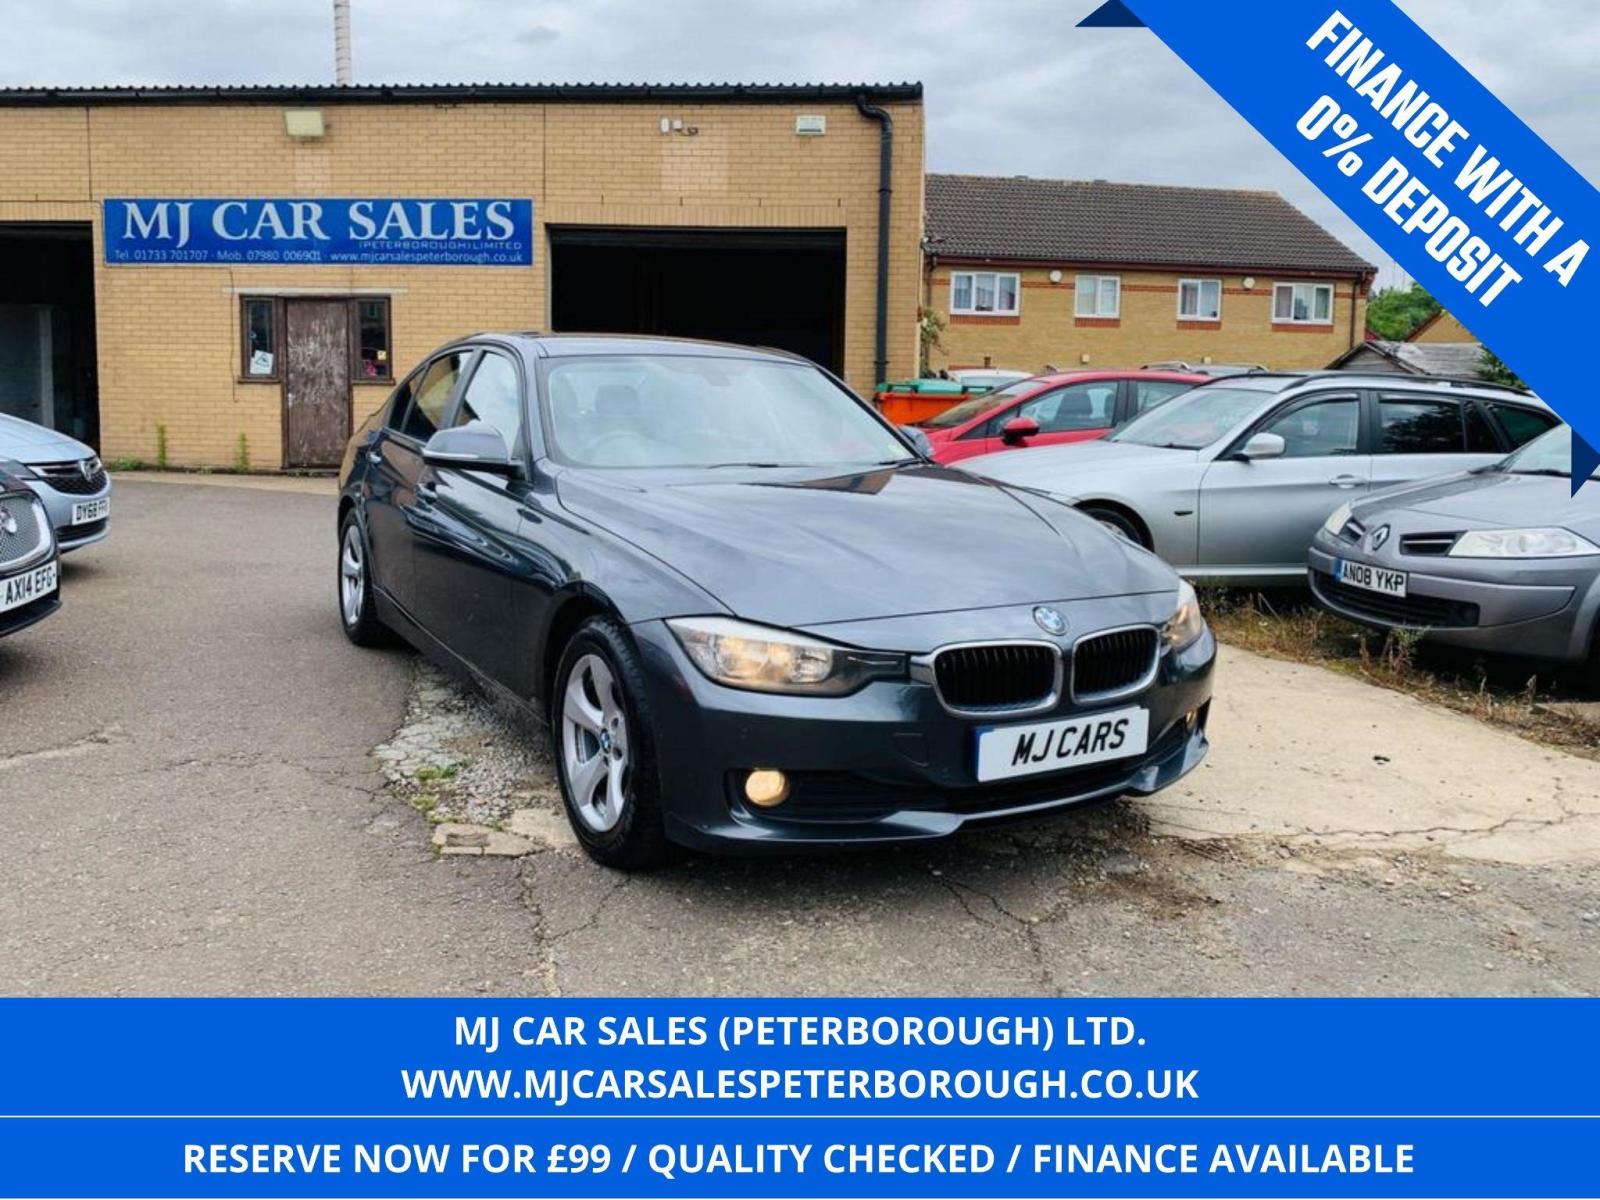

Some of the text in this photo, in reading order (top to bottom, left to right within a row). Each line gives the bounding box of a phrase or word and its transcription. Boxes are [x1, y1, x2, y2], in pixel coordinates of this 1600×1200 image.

[122, 200, 516, 248] MJ CAR SALES
[134, 249, 167, 261] 01733
[171, 249, 209, 261] 701707
[246, 249, 280, 261] 07980
[330, 250, 523, 263] www.mjcarsalespeterborough.co.uk
[5, 574, 32, 605] AX14
[1343, 563, 1404, 592] AN08 YKP
[1011, 718, 1129, 767] MJ CARS
